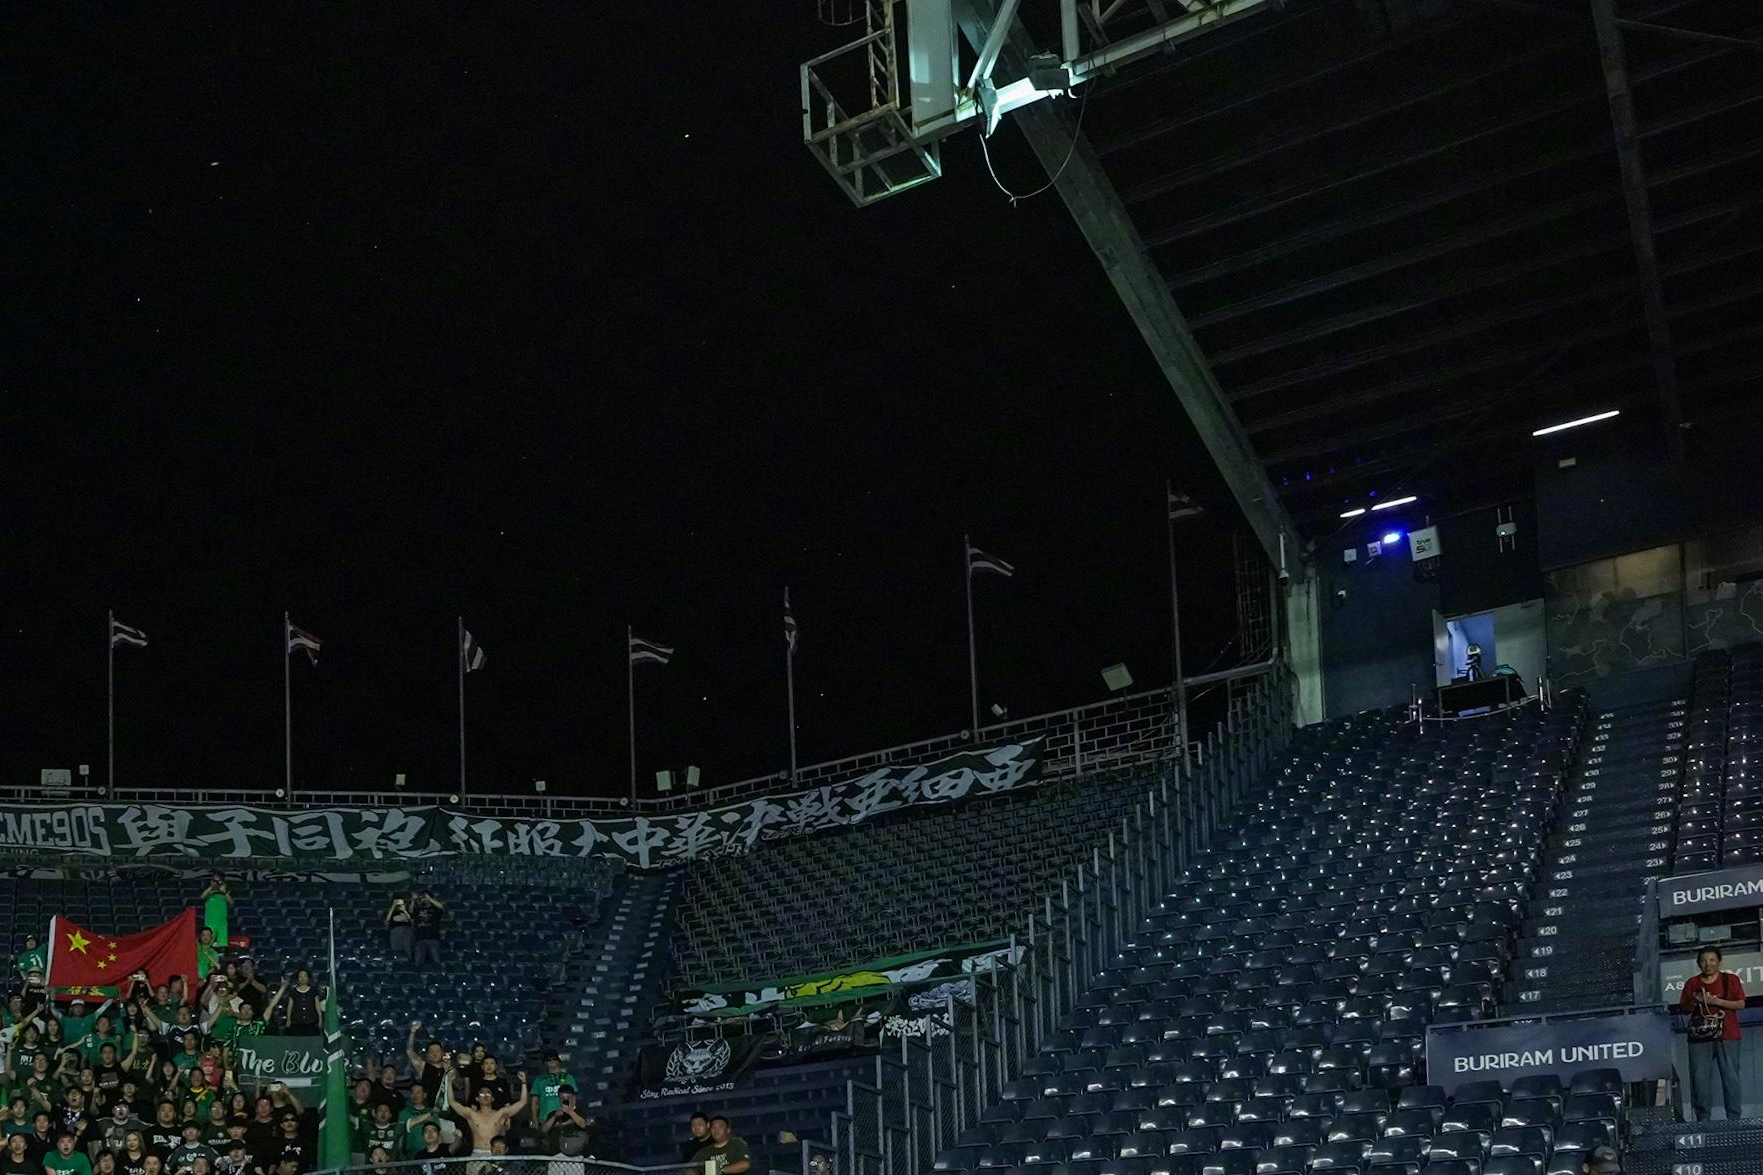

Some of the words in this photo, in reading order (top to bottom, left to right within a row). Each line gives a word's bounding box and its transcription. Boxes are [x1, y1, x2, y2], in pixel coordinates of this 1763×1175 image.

[1673, 880, 1763, 905] BURIRAM
[238, 1049, 276, 1078] The
[1453, 1049, 1554, 1074] BURIRAM
[1561, 1040, 1644, 1065] UNITED
[1689, 1134, 1702, 1145] 11
[1686, 1164, 1701, 1175] 10
